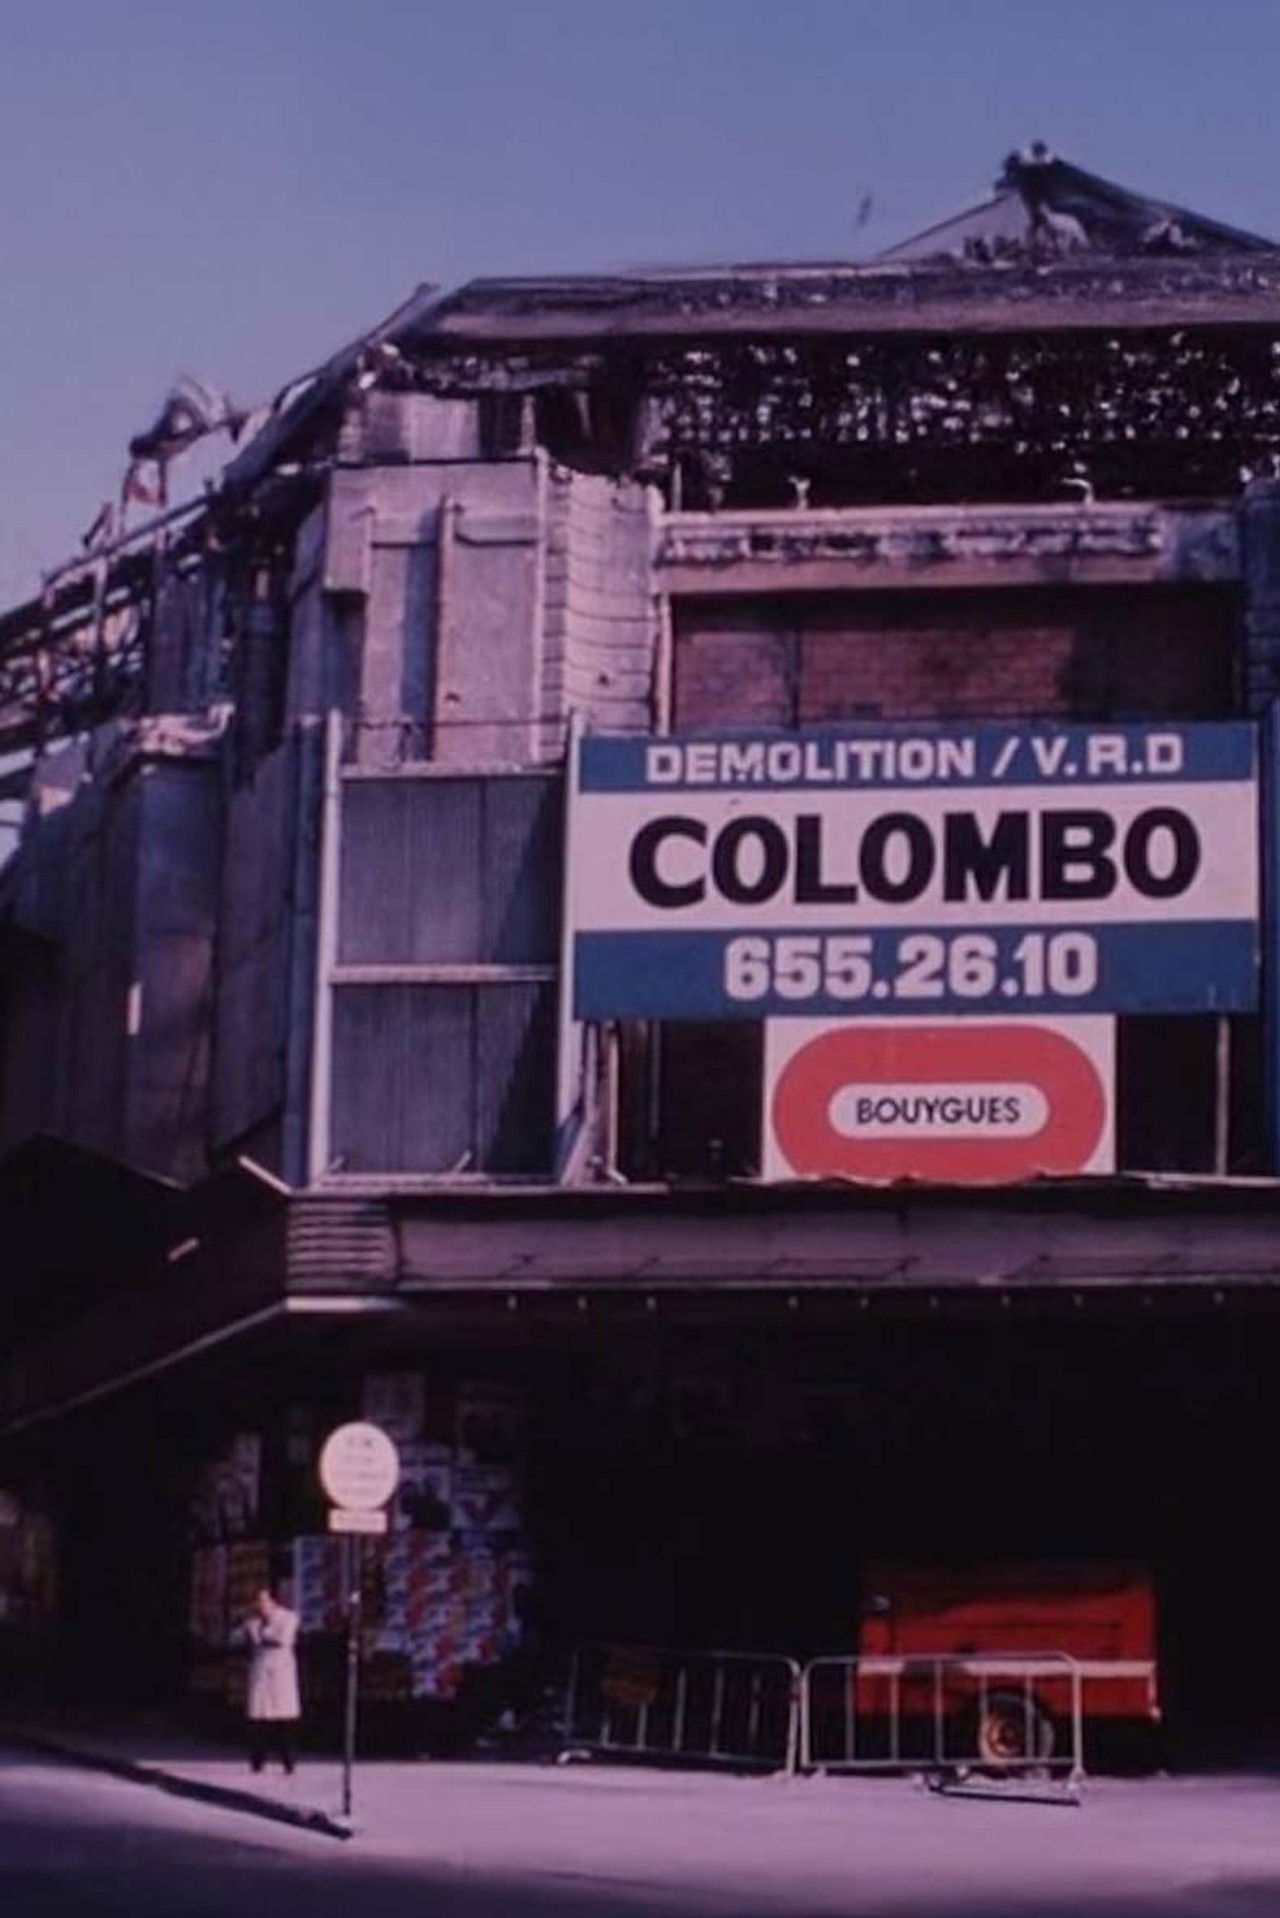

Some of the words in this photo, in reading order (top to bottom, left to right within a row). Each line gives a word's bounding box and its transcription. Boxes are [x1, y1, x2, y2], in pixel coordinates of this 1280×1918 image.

[646, 738, 975, 783] DEMOLITION
[629, 807, 1200, 908] COLOMBO
[724, 932, 1097, 999] 655.26.10
[855, 1097, 1021, 1124] BOUYGUES
